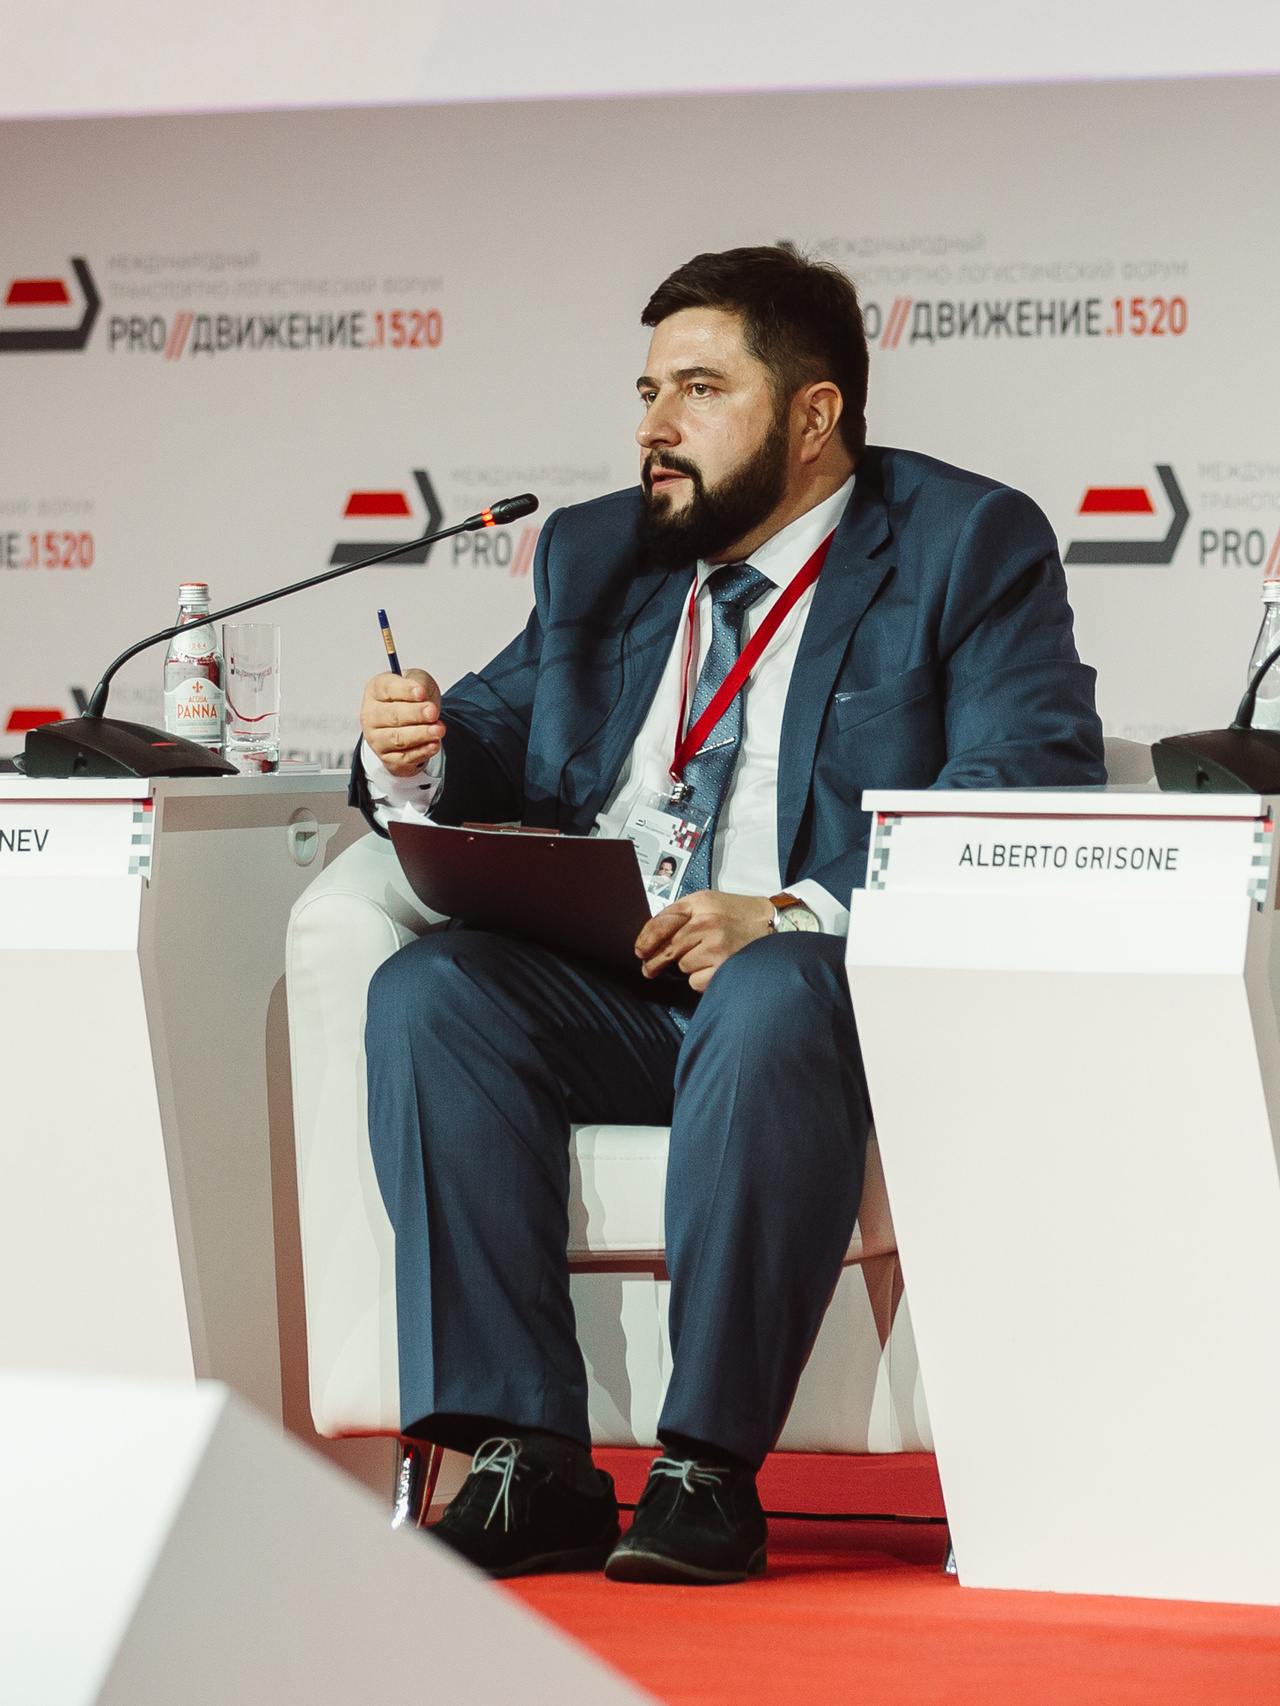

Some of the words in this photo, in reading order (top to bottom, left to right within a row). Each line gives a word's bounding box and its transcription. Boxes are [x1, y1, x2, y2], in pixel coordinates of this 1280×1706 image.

[177, 704, 218, 719] PANNA
[958, 843, 1069, 869] ALBERTO
[1074, 846, 1180, 871] GRISONE
